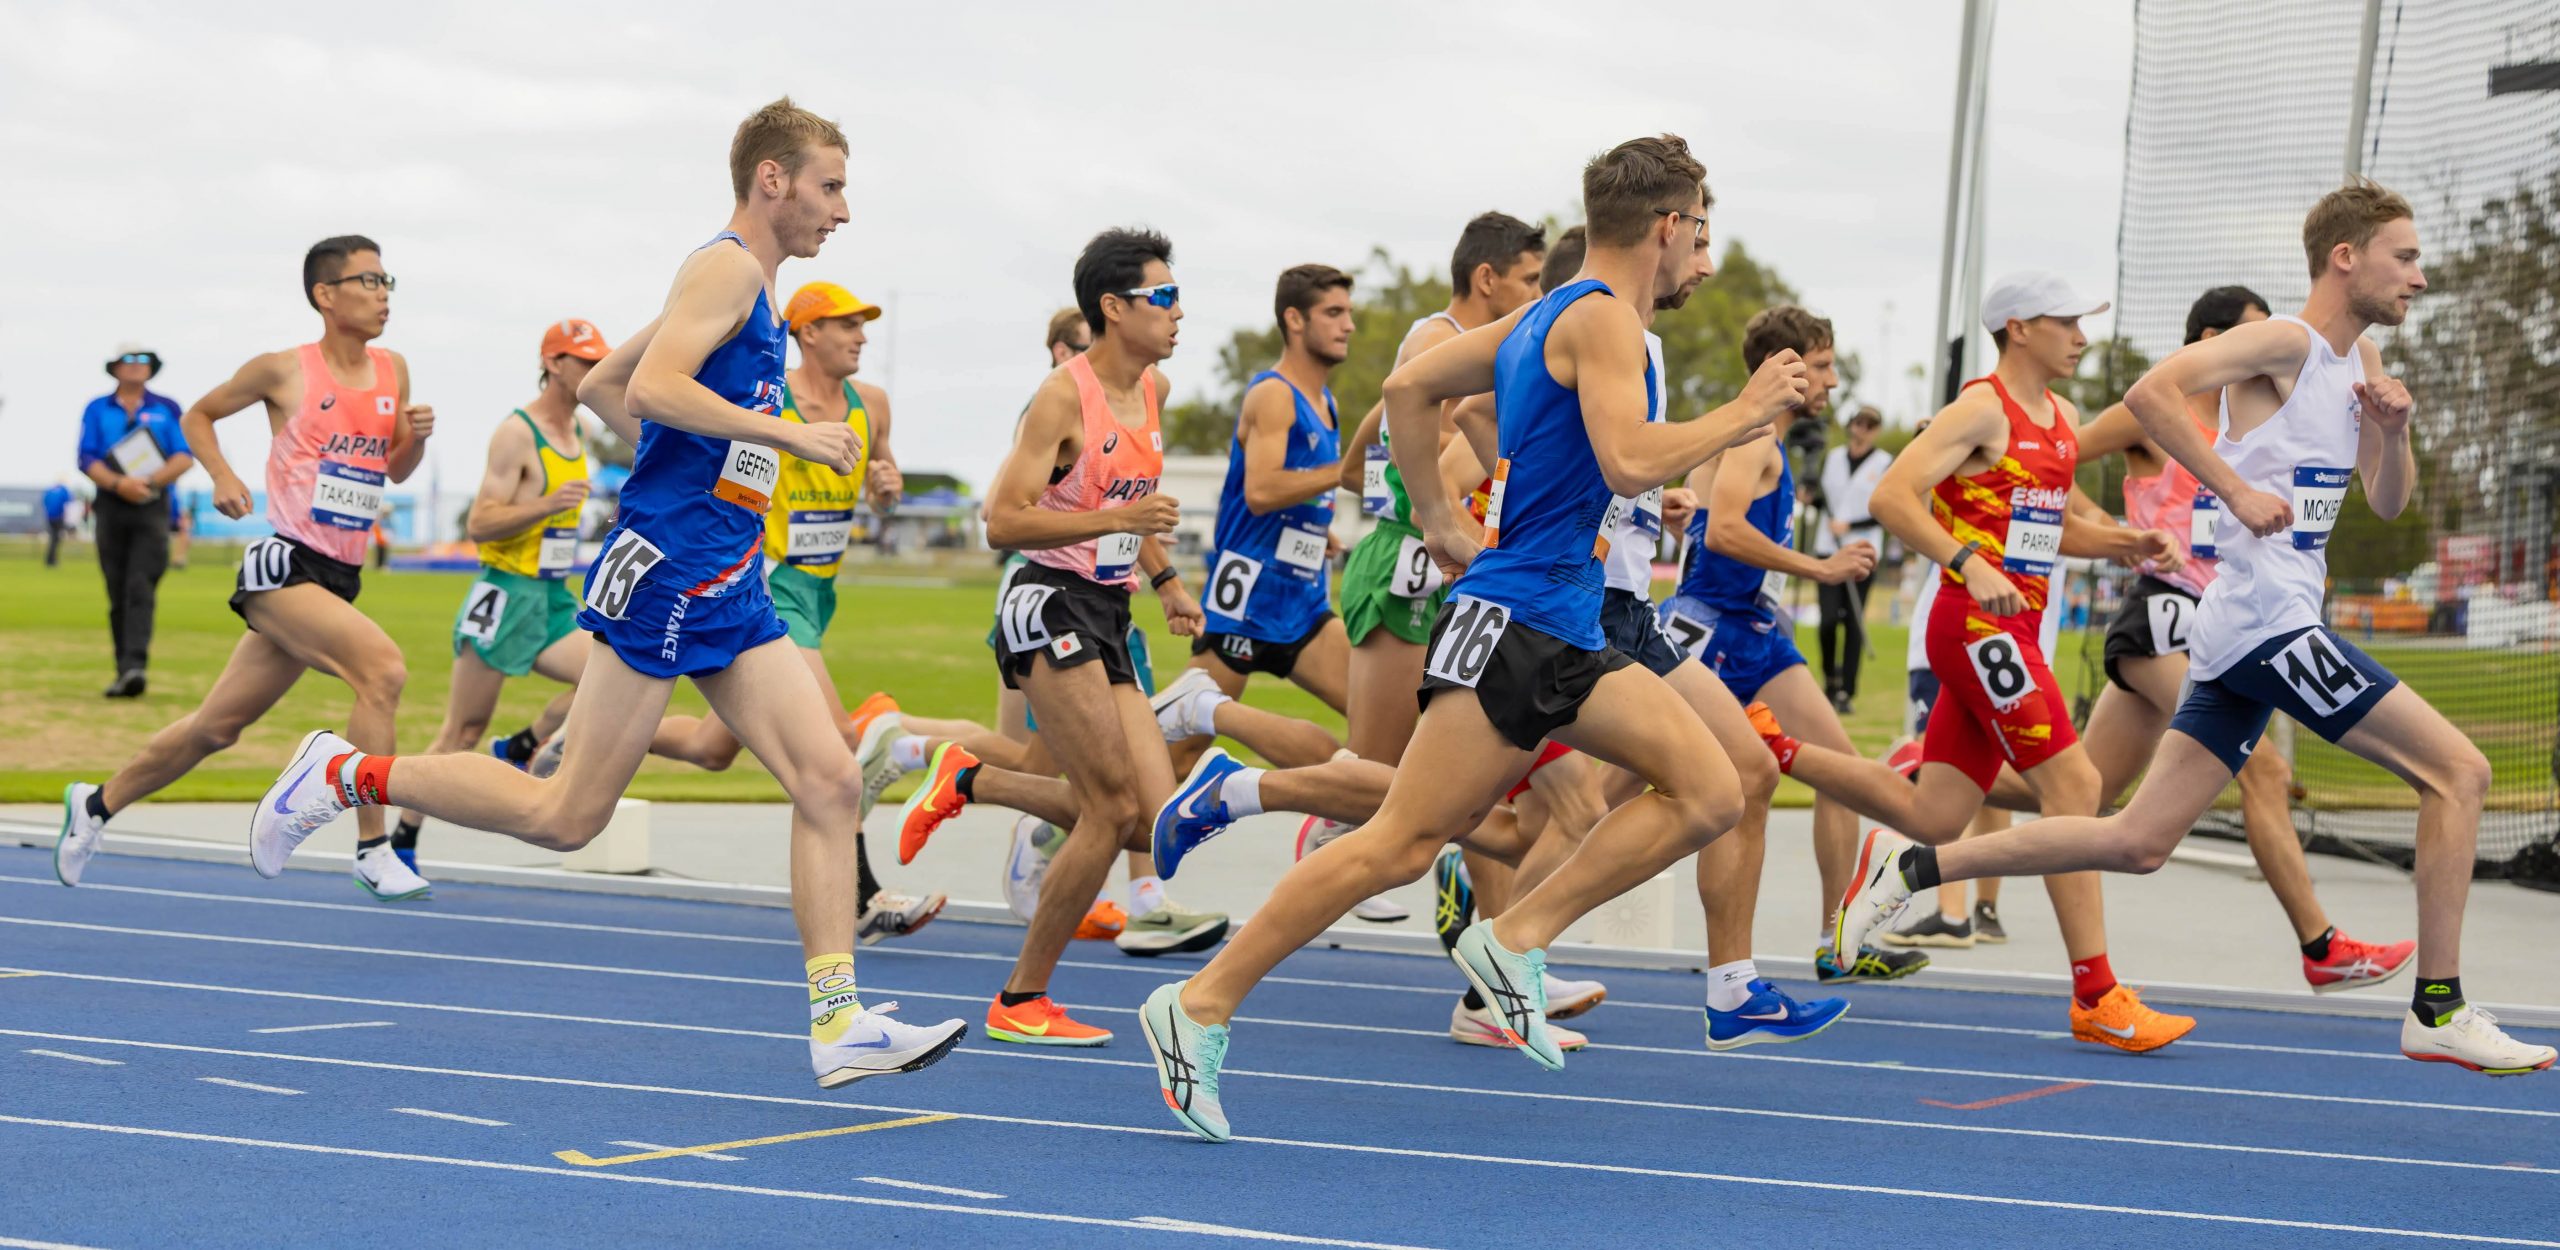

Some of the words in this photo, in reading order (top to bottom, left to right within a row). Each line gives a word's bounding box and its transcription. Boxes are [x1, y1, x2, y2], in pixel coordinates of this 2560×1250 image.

[249, 542, 286, 586] 10
[594, 537, 659, 618] 15
[1215, 559, 1251, 612] 6
[1407, 545, 1430, 594] 9
[467, 589, 499, 634] 4
[661, 593, 691, 662] FRANCE
[1009, 589, 1045, 645] 12
[2162, 599, 2187, 648] 2
[1222, 634, 1253, 657] ITA
[1441, 600, 1504, 682] 16
[1978, 637, 2025, 699] 8
[2284, 633, 2363, 710] 14
